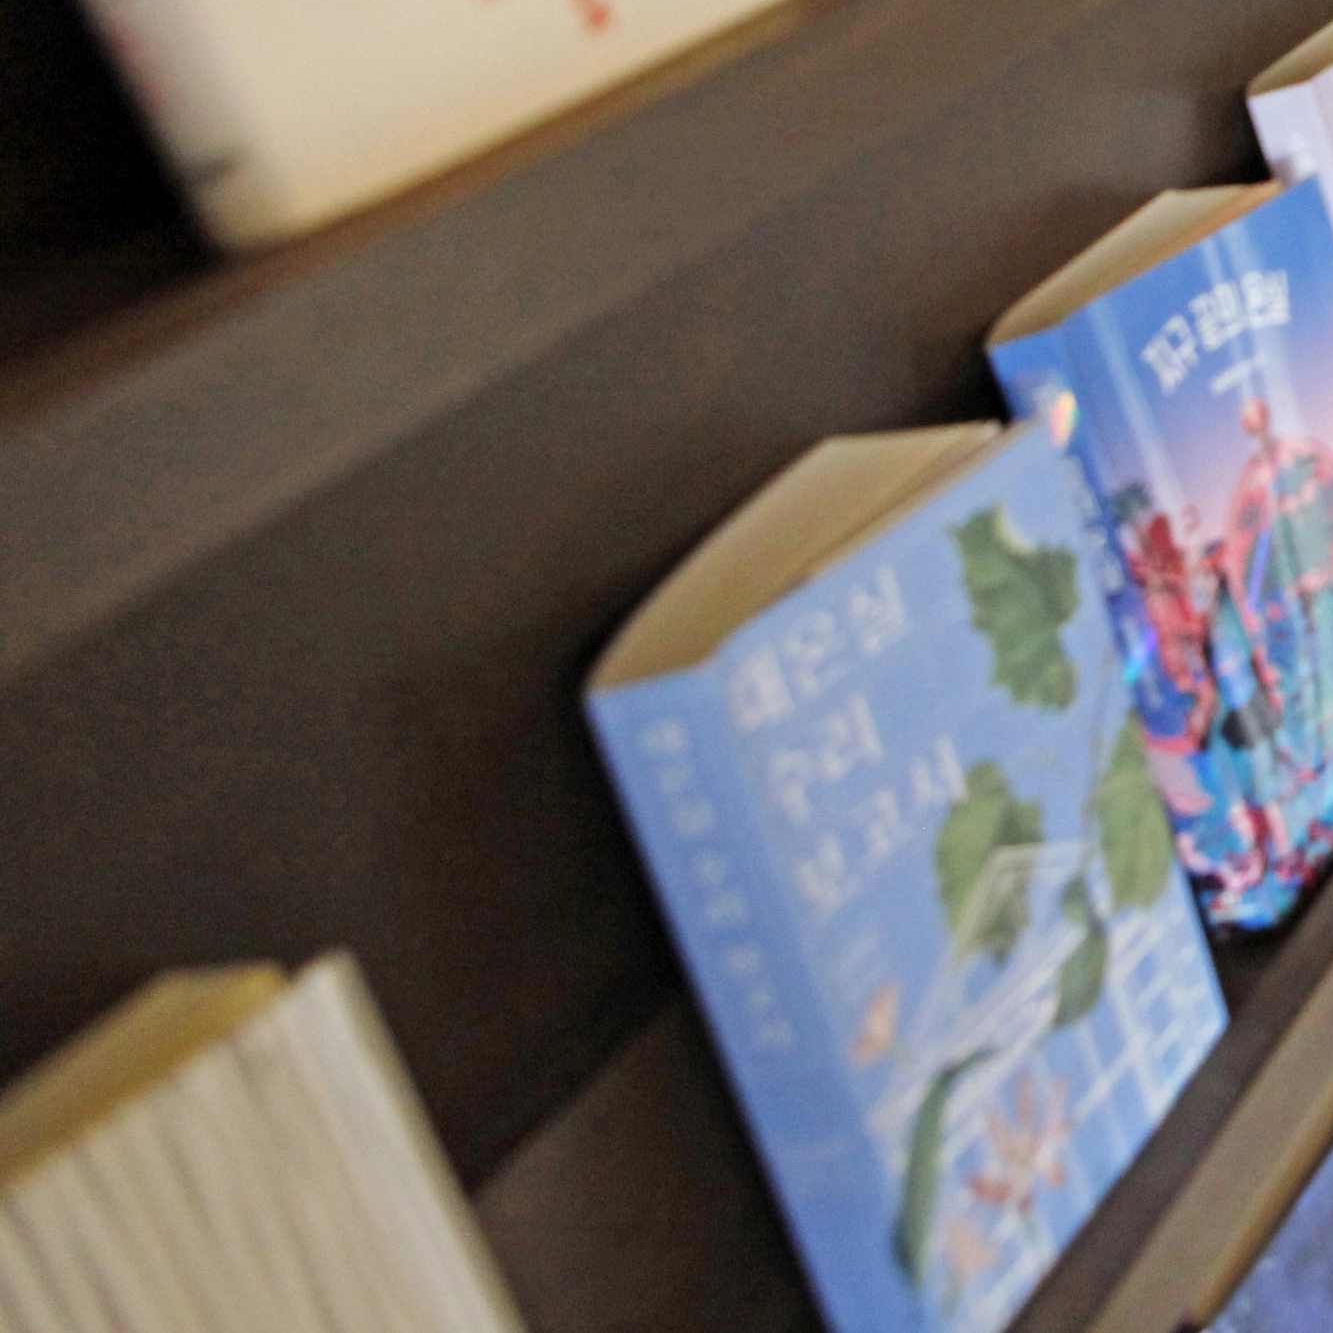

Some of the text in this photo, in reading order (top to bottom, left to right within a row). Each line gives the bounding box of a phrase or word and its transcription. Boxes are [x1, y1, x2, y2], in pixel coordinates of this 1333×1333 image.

[1141, 311, 1197, 396] 지구
[1238, 268, 1292, 338] 온실
[726, 564, 912, 734] 대온실
[768, 693, 882, 823] 수리
[800, 734, 968, 912] 보고서
